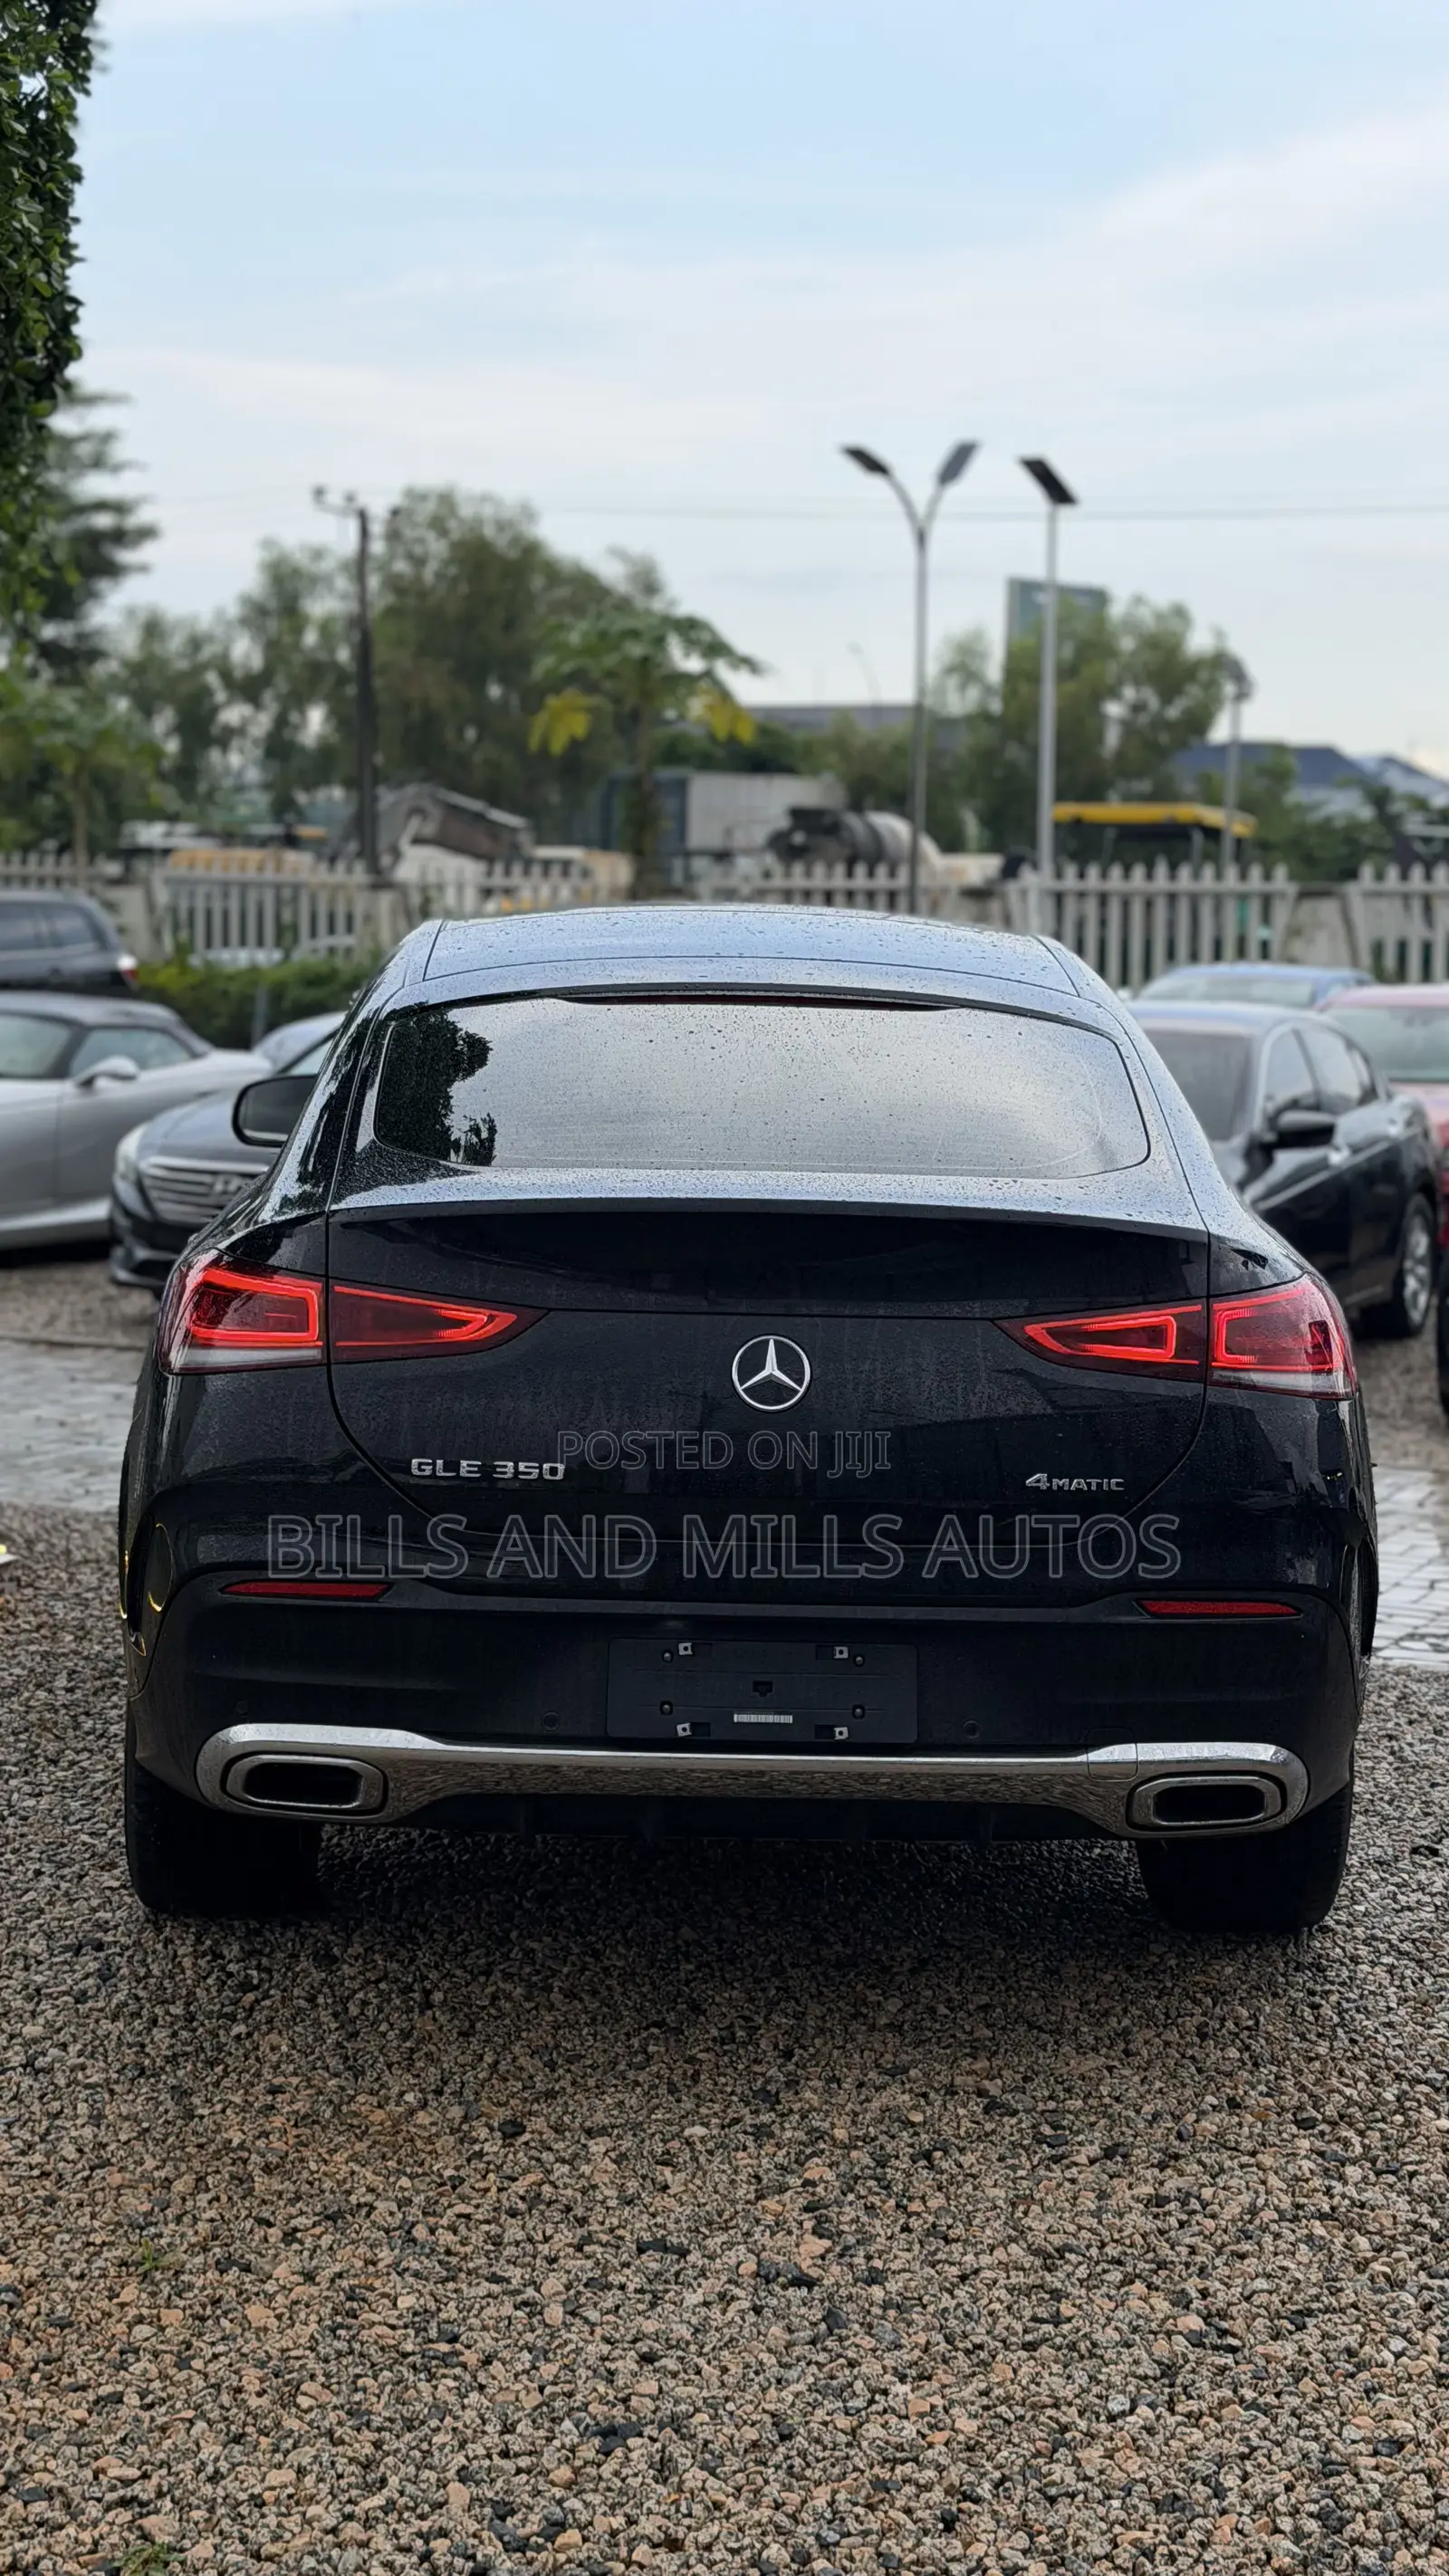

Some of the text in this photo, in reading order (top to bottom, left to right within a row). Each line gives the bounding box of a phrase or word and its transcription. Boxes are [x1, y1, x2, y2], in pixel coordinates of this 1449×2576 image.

[410, 1458, 566, 1480] GLE 350
[1025, 1473, 1126, 1491] 4MATIC
